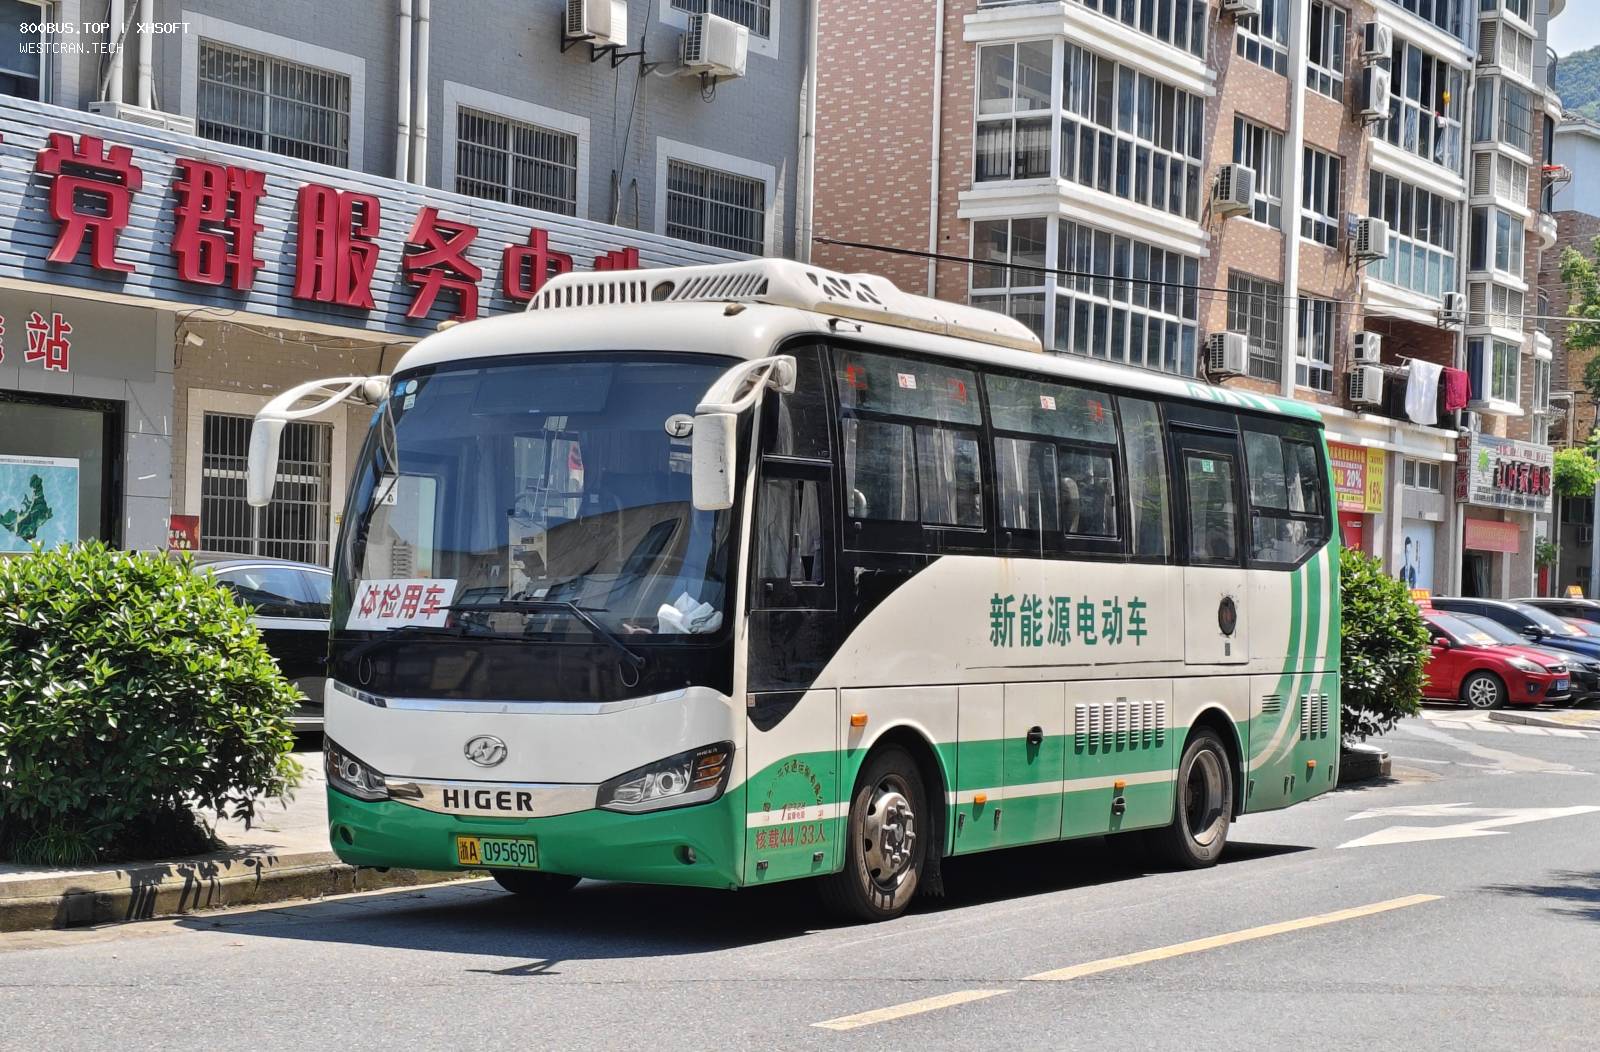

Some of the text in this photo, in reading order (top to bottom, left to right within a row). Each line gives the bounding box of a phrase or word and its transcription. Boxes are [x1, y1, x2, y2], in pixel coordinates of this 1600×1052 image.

[36, 132, 639, 322] 党群服务中
[0, 311, 73, 373] 站
[357, 584, 446, 620] 体检用车
[989, 592, 1148, 648] 新能源电动车
[443, 788, 534, 812] HIGER
